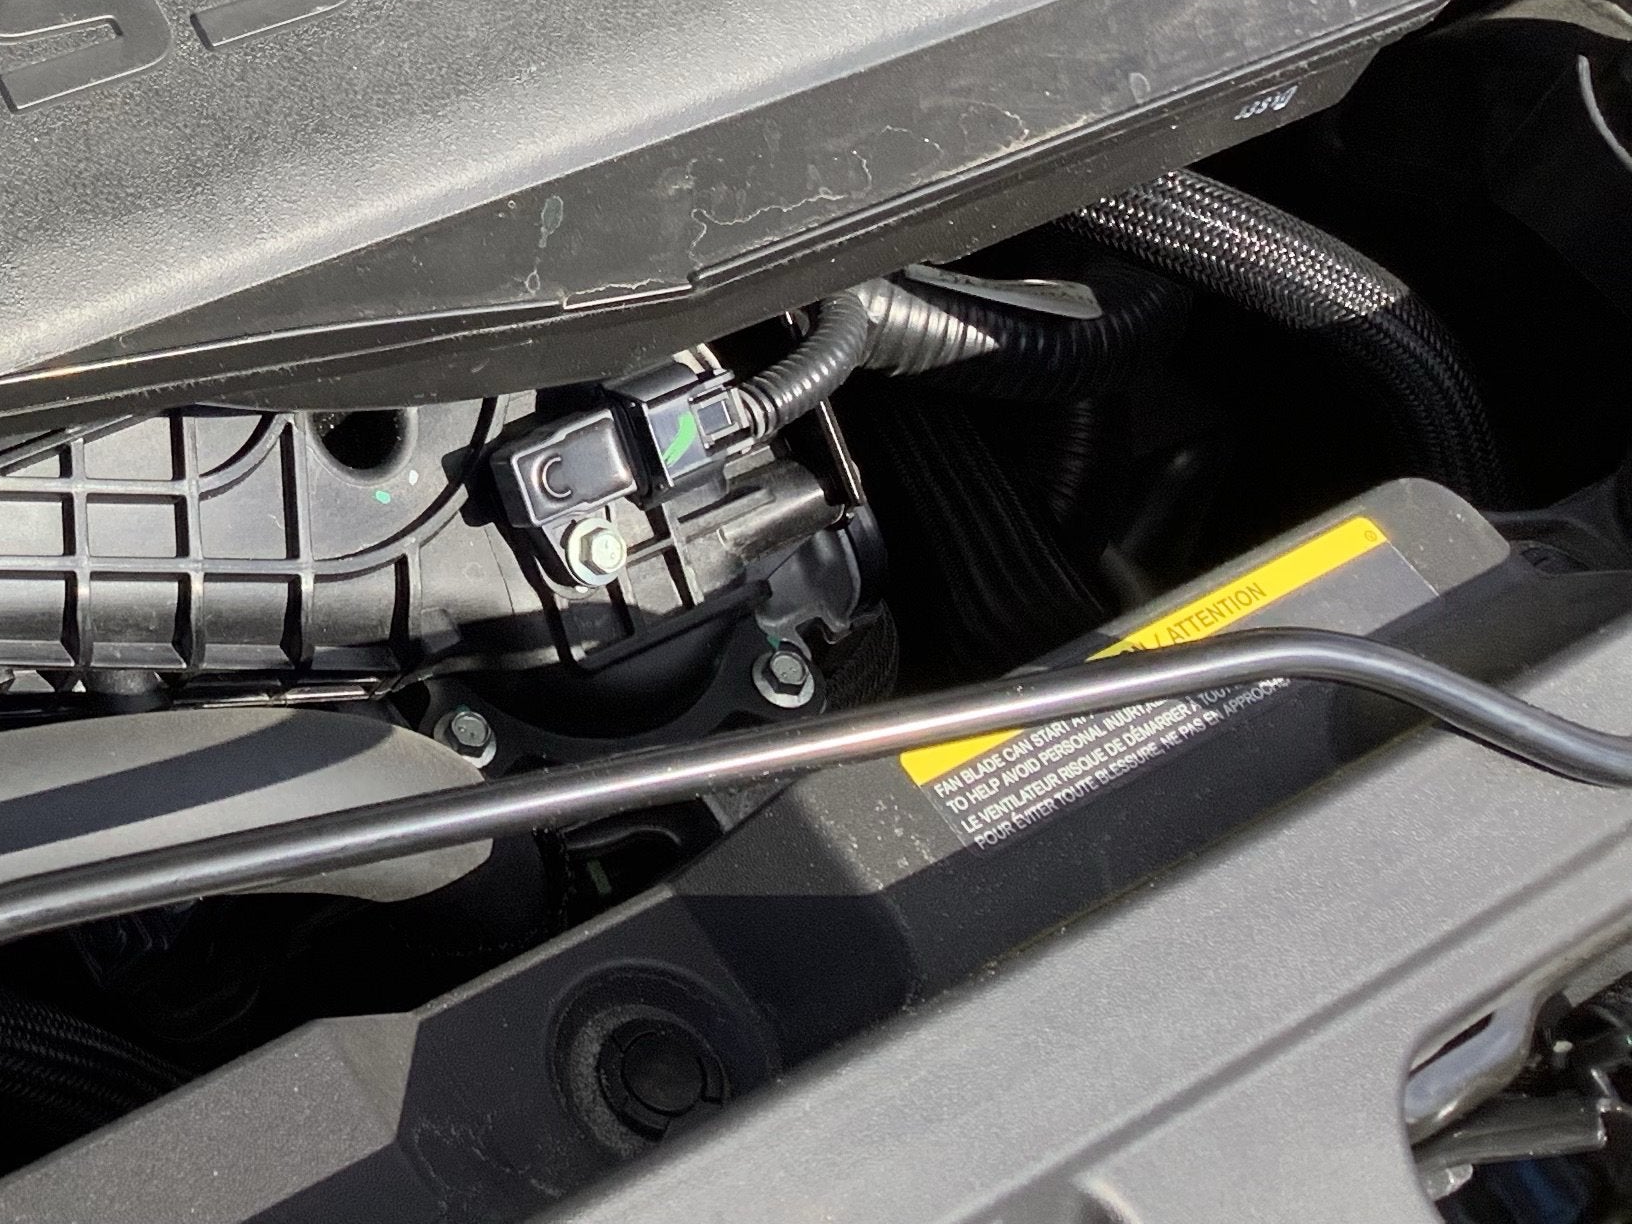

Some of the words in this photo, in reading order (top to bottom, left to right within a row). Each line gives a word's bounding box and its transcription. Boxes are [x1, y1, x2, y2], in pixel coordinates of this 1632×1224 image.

[1167, 581, 1267, 645] ATTENTION
[934, 775, 964, 798] FAN
[960, 753, 1006, 784] BLADE
[1002, 739, 1034, 762] CAN
[1030, 720, 1071, 747] START
[946, 799, 968, 814] TO
[966, 778, 1000, 805] HELP
[1002, 759, 1041, 787] AVOID
[1038, 723, 1108, 766] PERSONAL
[961, 815, 984, 834] LE
[978, 774, 1063, 824] VENTILATEUR
[1057, 747, 1108, 782] RISQUE
[1104, 738, 1128, 757] DE
[1125, 703, 1193, 748] DÉMARRER
[974, 821, 1017, 850] POUR
[1011, 797, 1059, 830] ÉVITER
[1054, 775, 1099, 806] TOUTE
[1095, 741, 1166, 783] BLESSURE,
[1160, 730, 1183, 751] NE
[1178, 718, 1207, 740] PAS
[1202, 708, 1225, 726] EN
